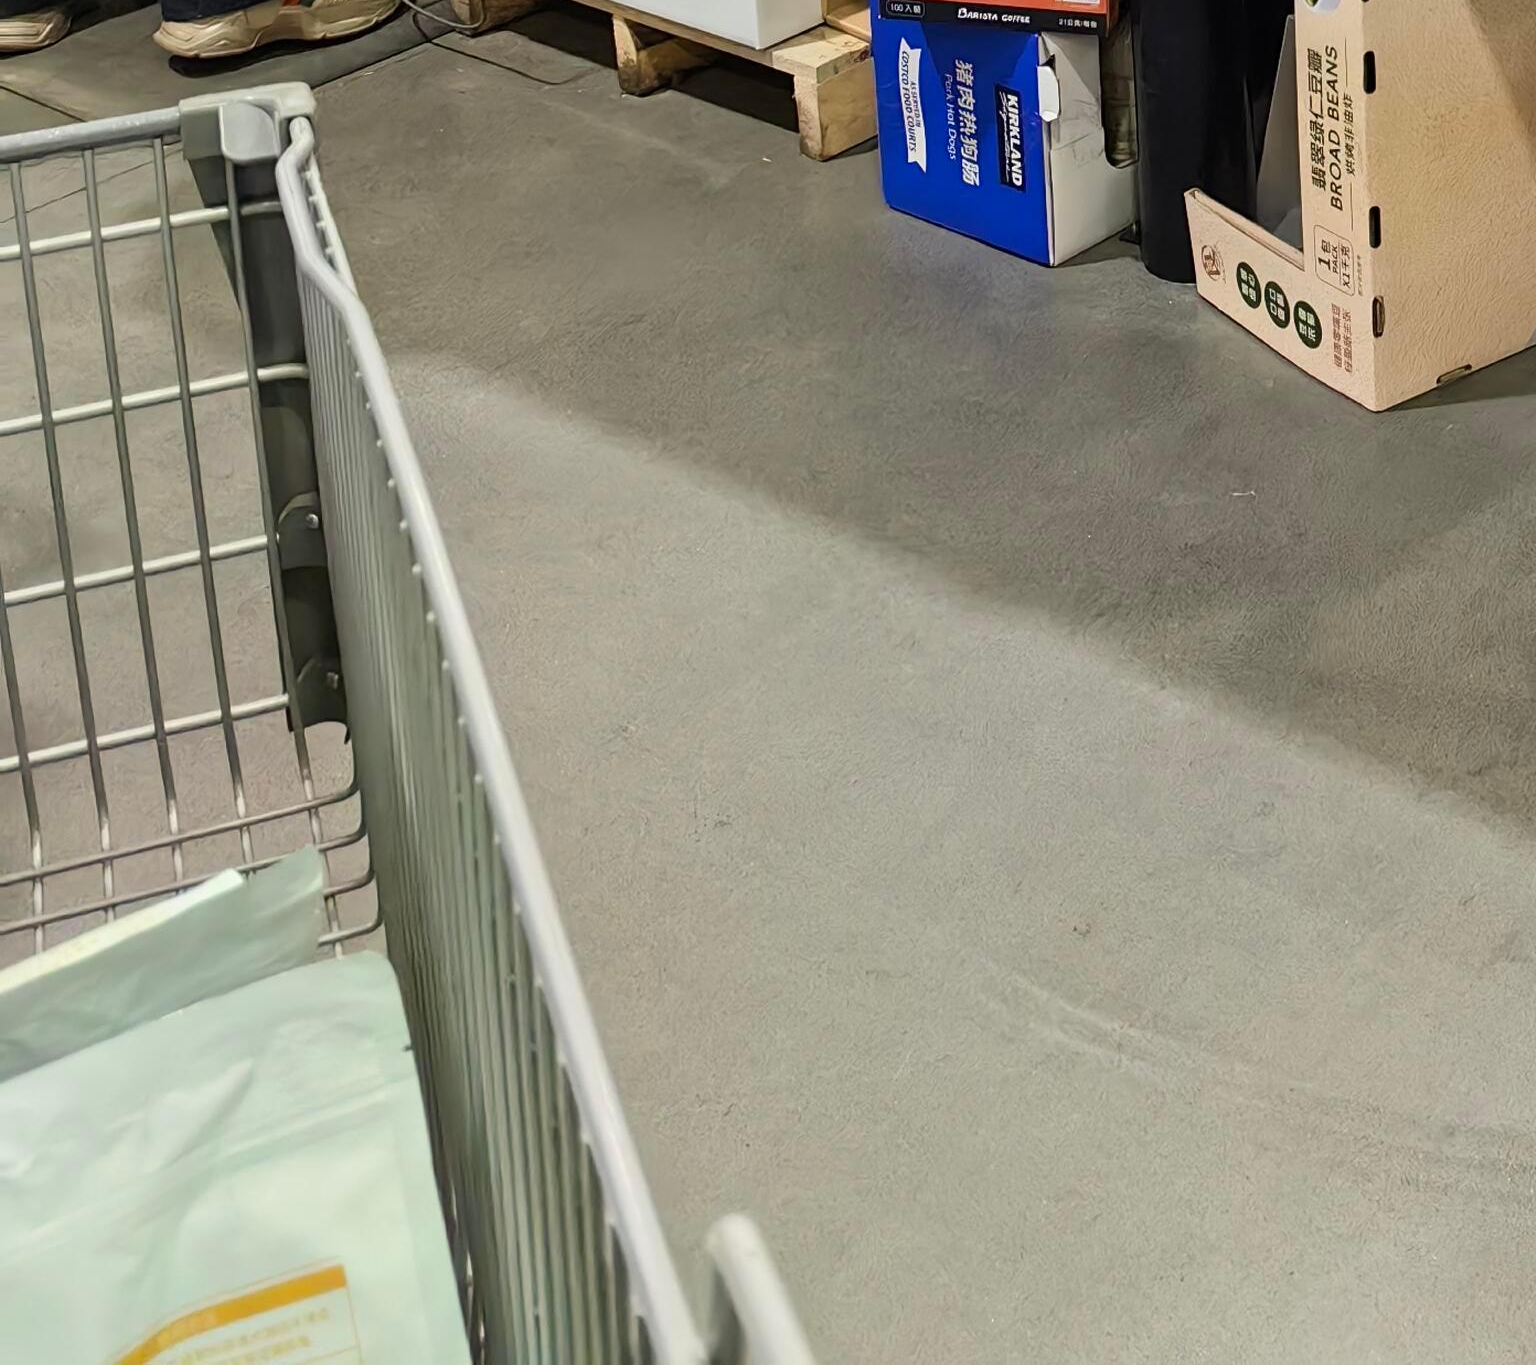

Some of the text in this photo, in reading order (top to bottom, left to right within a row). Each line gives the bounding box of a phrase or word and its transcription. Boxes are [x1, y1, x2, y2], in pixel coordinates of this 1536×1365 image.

[957, 7, 1030, 24] BARISTA COFFEE
[901, 51, 910, 86] COSTCO
[907, 114, 917, 153] COURTS
[944, 73, 958, 161] Pork Hot Dogs
[955, 59, 980, 187] 猪肉热狗肠
[1007, 94, 1023, 187] KIRKLAND
[1307, 48, 1326, 191] 翡翠绿仁豆瓣
[1325, 45, 1343, 212] BROAD BEANS
